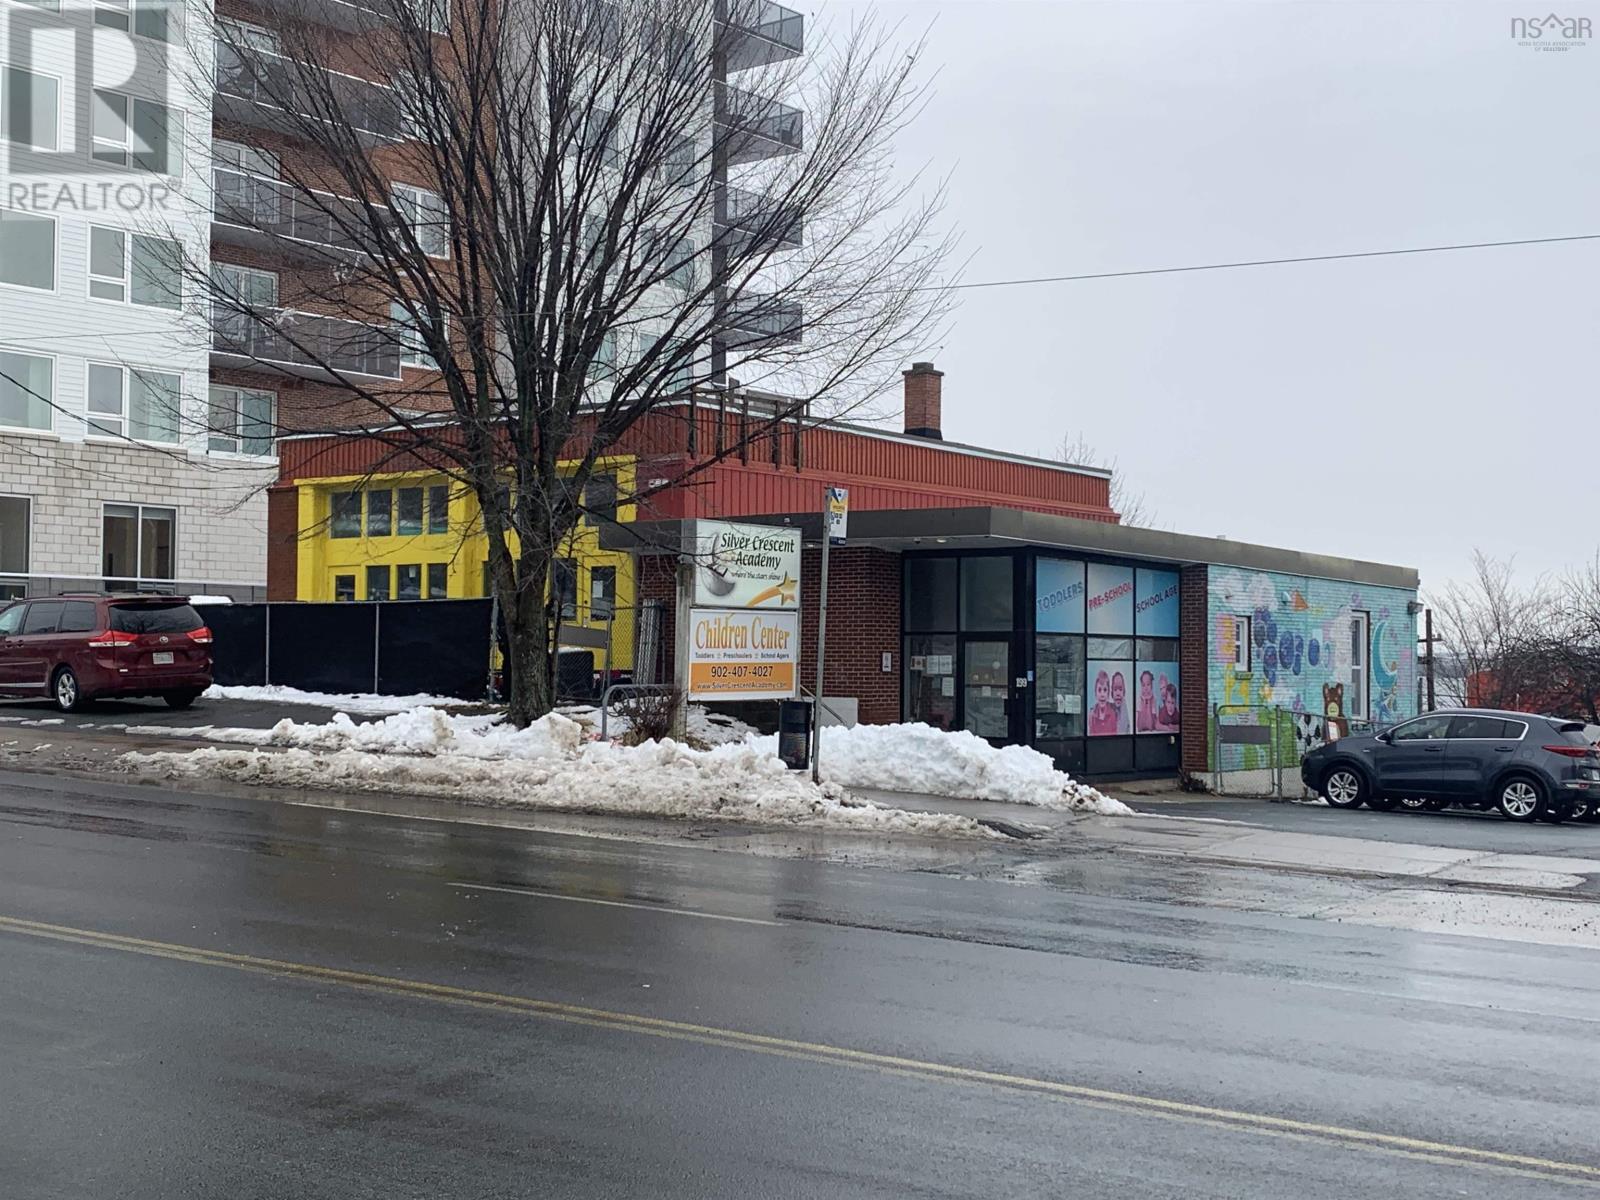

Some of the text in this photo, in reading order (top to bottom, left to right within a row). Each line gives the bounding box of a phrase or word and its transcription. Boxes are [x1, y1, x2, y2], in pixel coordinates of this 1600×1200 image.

[720, 532, 795, 553] Silver Crescent
[735, 551, 781, 570] Academy
[1038, 581, 1084, 611] TODDLERS
[1088, 582, 1132, 611] PRE-SCHOOL
[1136, 584, 1178, 613] SCHOOL AGE
[695, 615, 790, 649] Children Center
[711, 665, 774, 678] 902-407-4027
